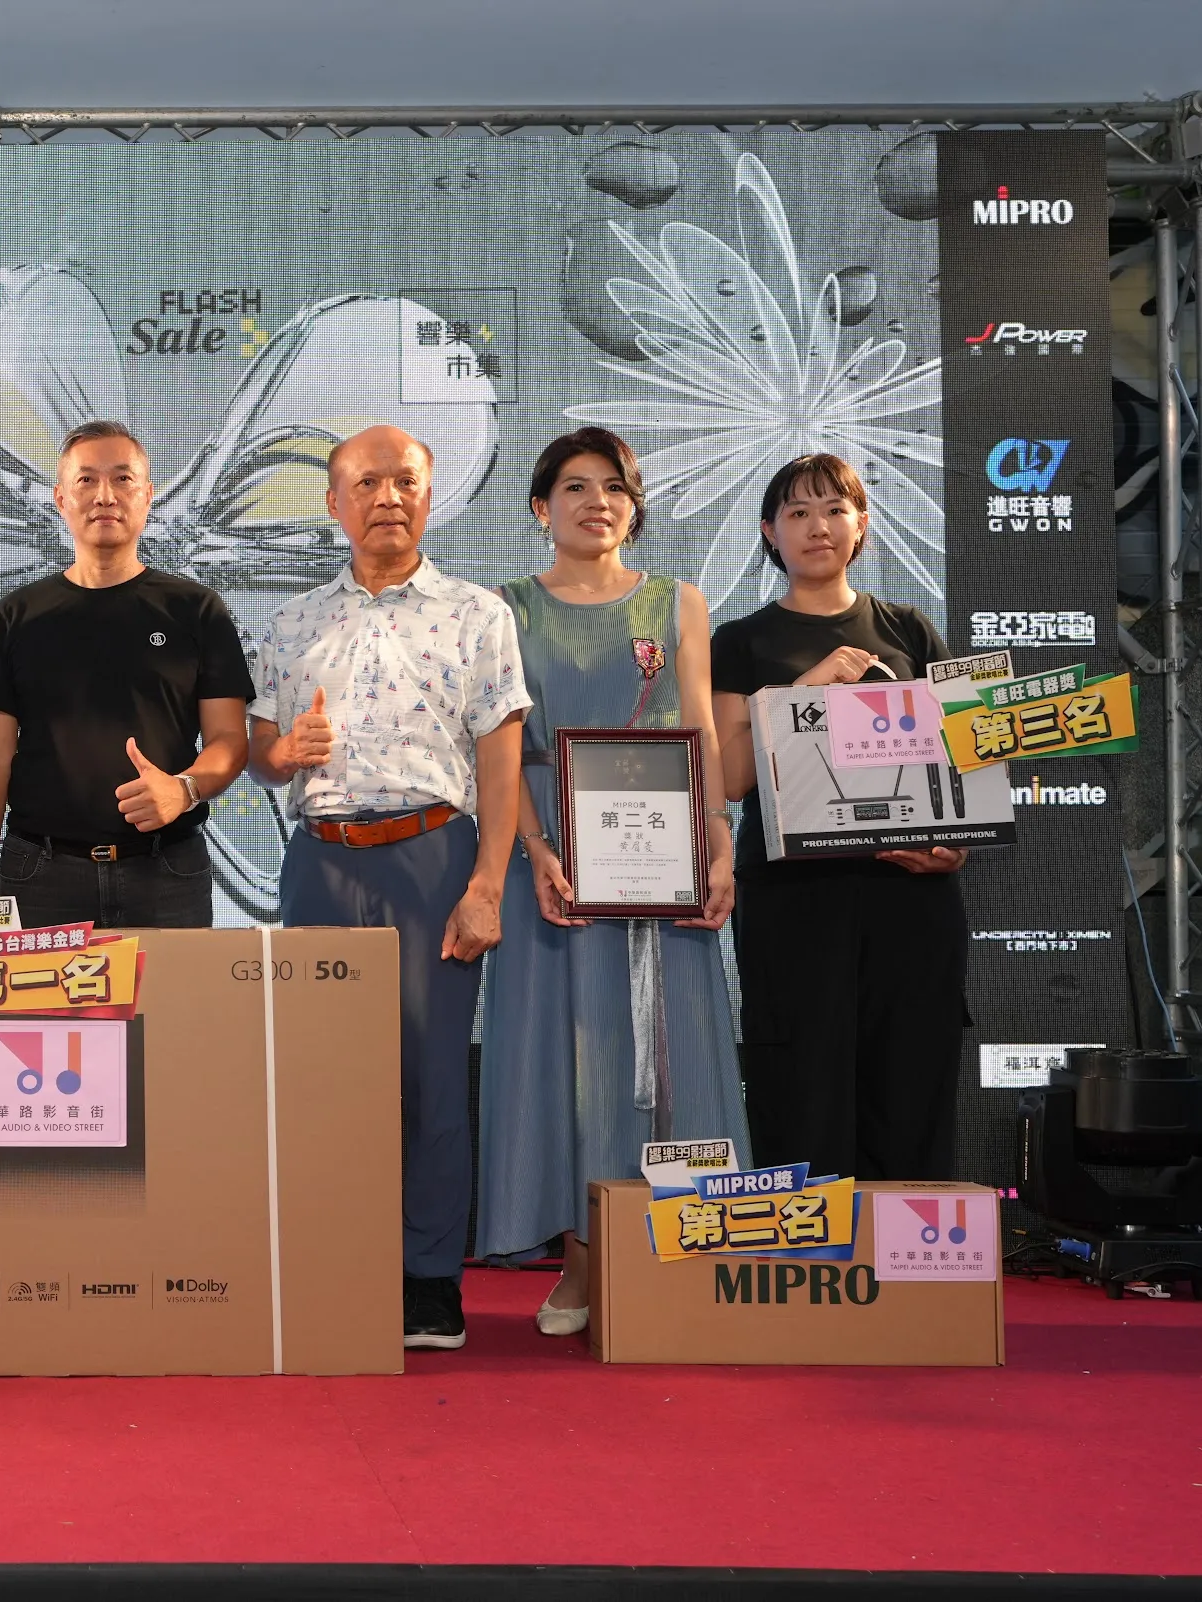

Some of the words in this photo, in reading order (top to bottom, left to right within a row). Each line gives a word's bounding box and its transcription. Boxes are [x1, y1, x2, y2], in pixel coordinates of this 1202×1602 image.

[973, 186, 1074, 225] MIPRO
[160, 289, 262, 314] FLASH
[127, 317, 227, 355] Sale
[417, 321, 471, 346] 響樂
[447, 354, 502, 378] 市集
[987, 496, 1073, 517] 進旺音響
[988, 518, 1072, 532] GWON
[970, 611, 1096, 640] 金亞家電
[932, 653, 1008, 682] 響樂99影音節
[992, 672, 1077, 705] 進旺電器獎
[972, 696, 1110, 761] 第三名
[844, 737, 934, 751] 中華路影音街
[915, 749, 935, 757] STREET
[601, 811, 665, 829] 第二名
[802, 837, 876, 848] PROFESSIONAL
[881, 833, 929, 845] WIRELESS
[933, 830, 998, 842] MICROPHONE
[1066, 930, 1112, 940] XIMEN
[1, 1123, 31, 1132] AUDIO
[34, 1123, 41, 1132] &
[43, 1123, 72, 1132] VIDEO
[74, 1123, 104, 1132] STREET
[648, 1142, 728, 1164] 響樂99影音節
[706, 1170, 793, 1196] MIPRO獎
[680, 1196, 827, 1248] 第二名
[889, 1250, 983, 1261] 中華路影音街
[35, 1281, 60, 1292] 雙頻
[82, 1284, 137, 1294] HDMI
[186, 1279, 228, 1295] Dolby
[715, 1263, 880, 1305] MIPRO
[38, 1293, 58, 1302] WiFi
